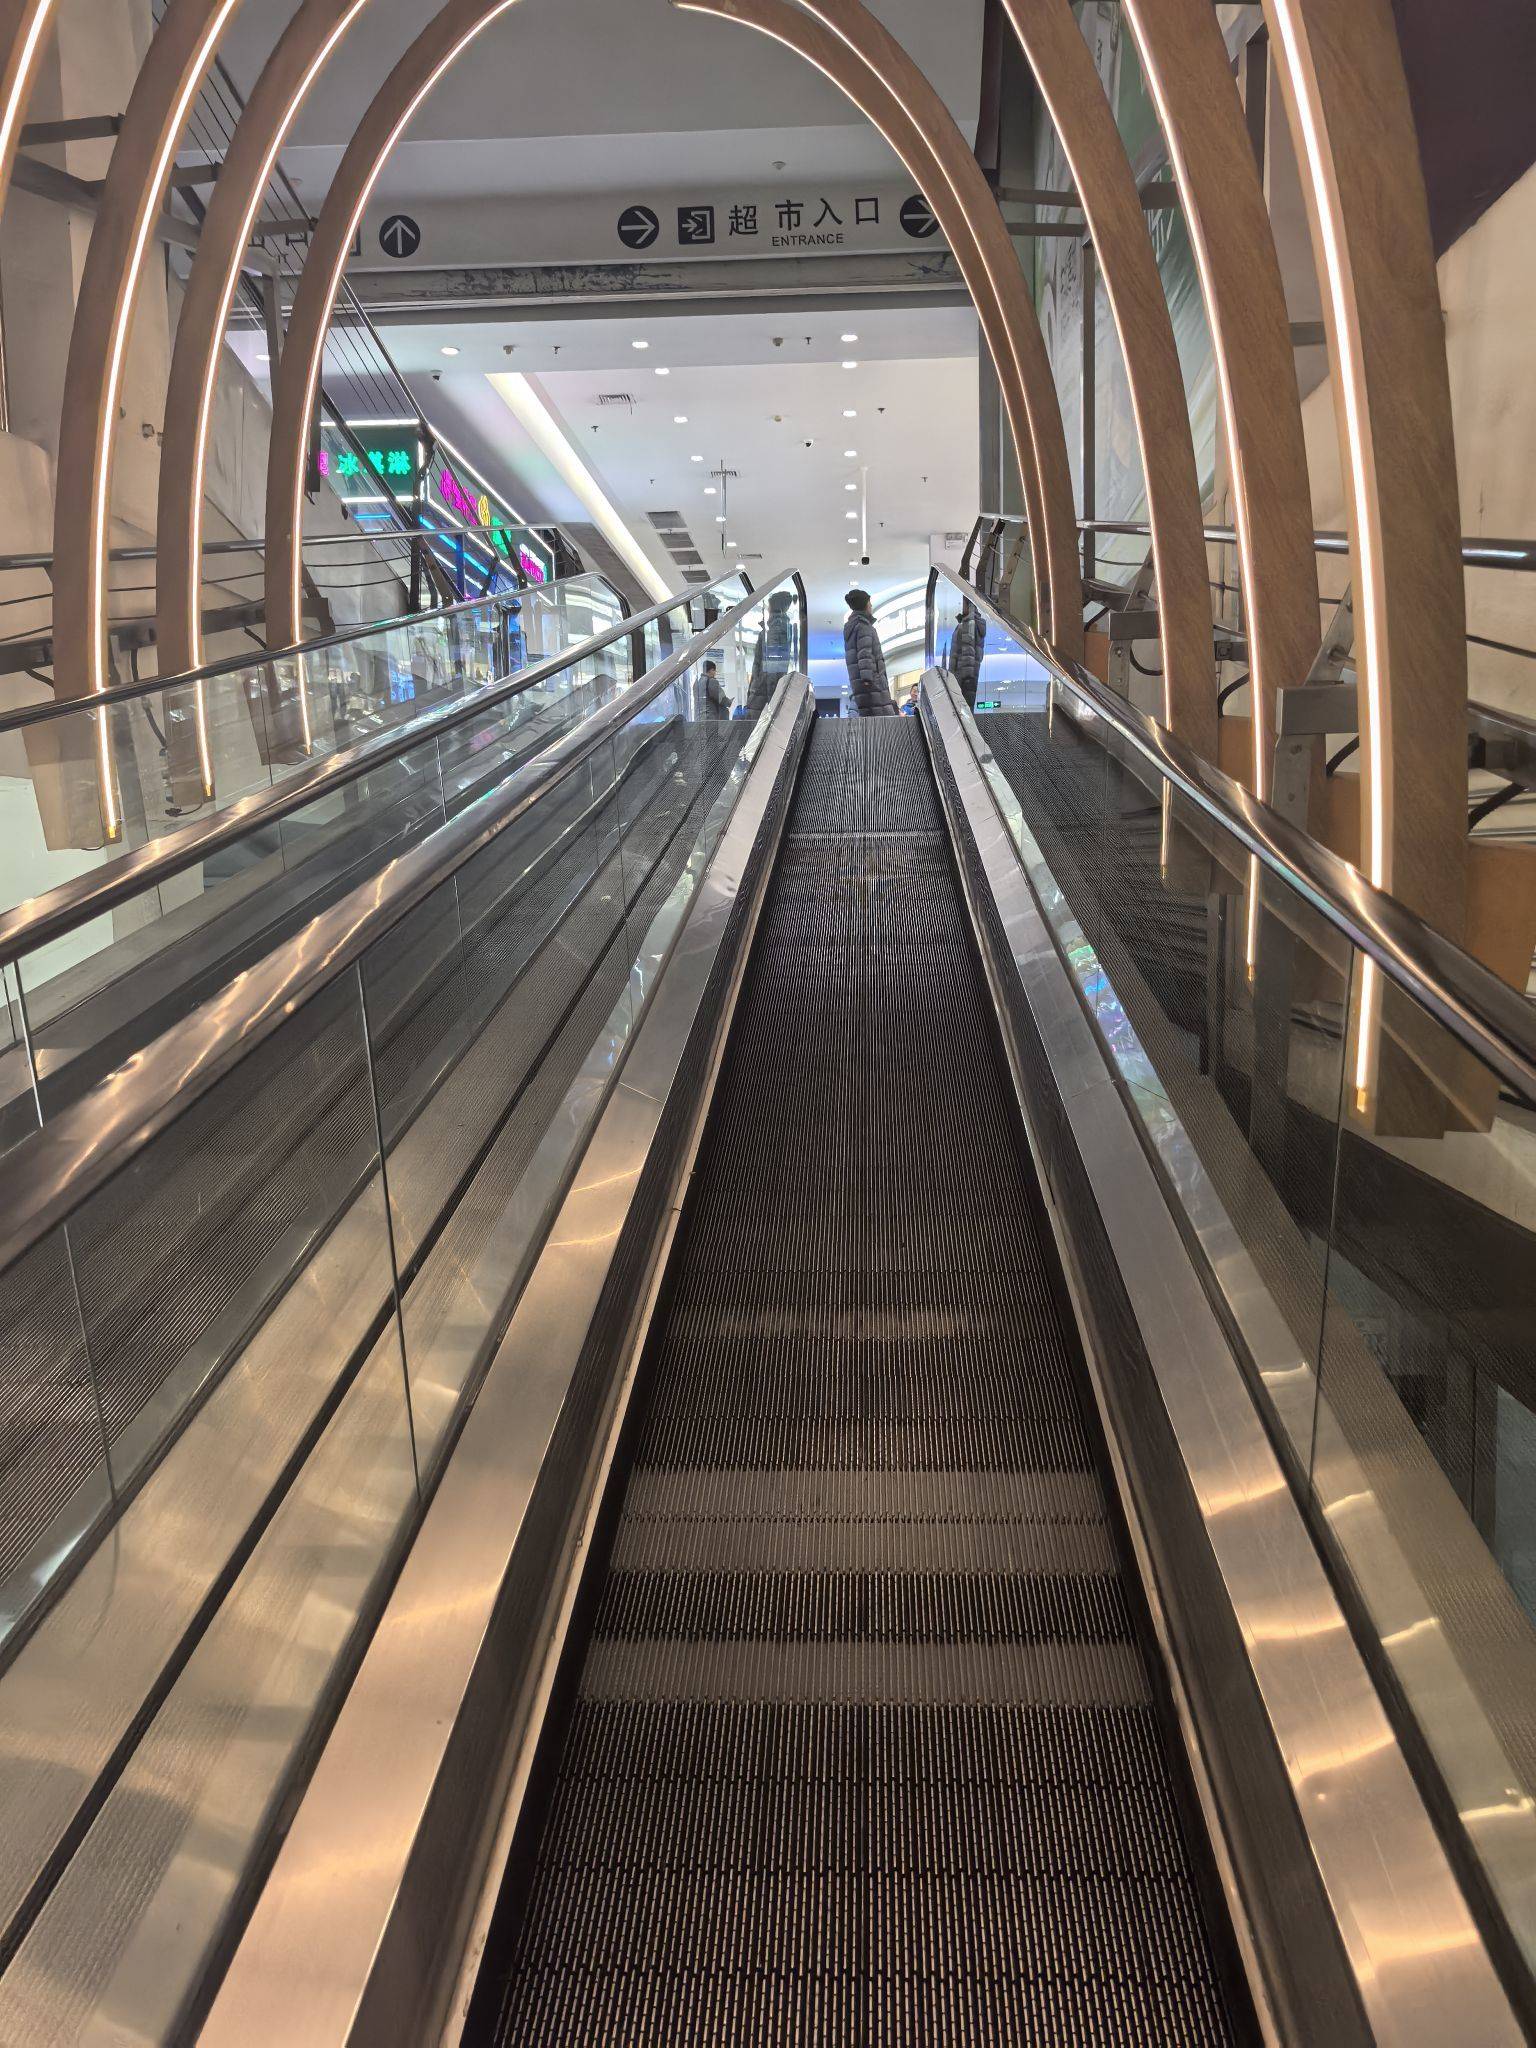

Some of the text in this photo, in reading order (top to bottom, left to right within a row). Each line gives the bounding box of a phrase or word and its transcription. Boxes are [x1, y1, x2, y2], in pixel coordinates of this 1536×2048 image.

[728, 197, 880, 236] 超市入口
[772, 233, 845, 247] ENTRANCE
